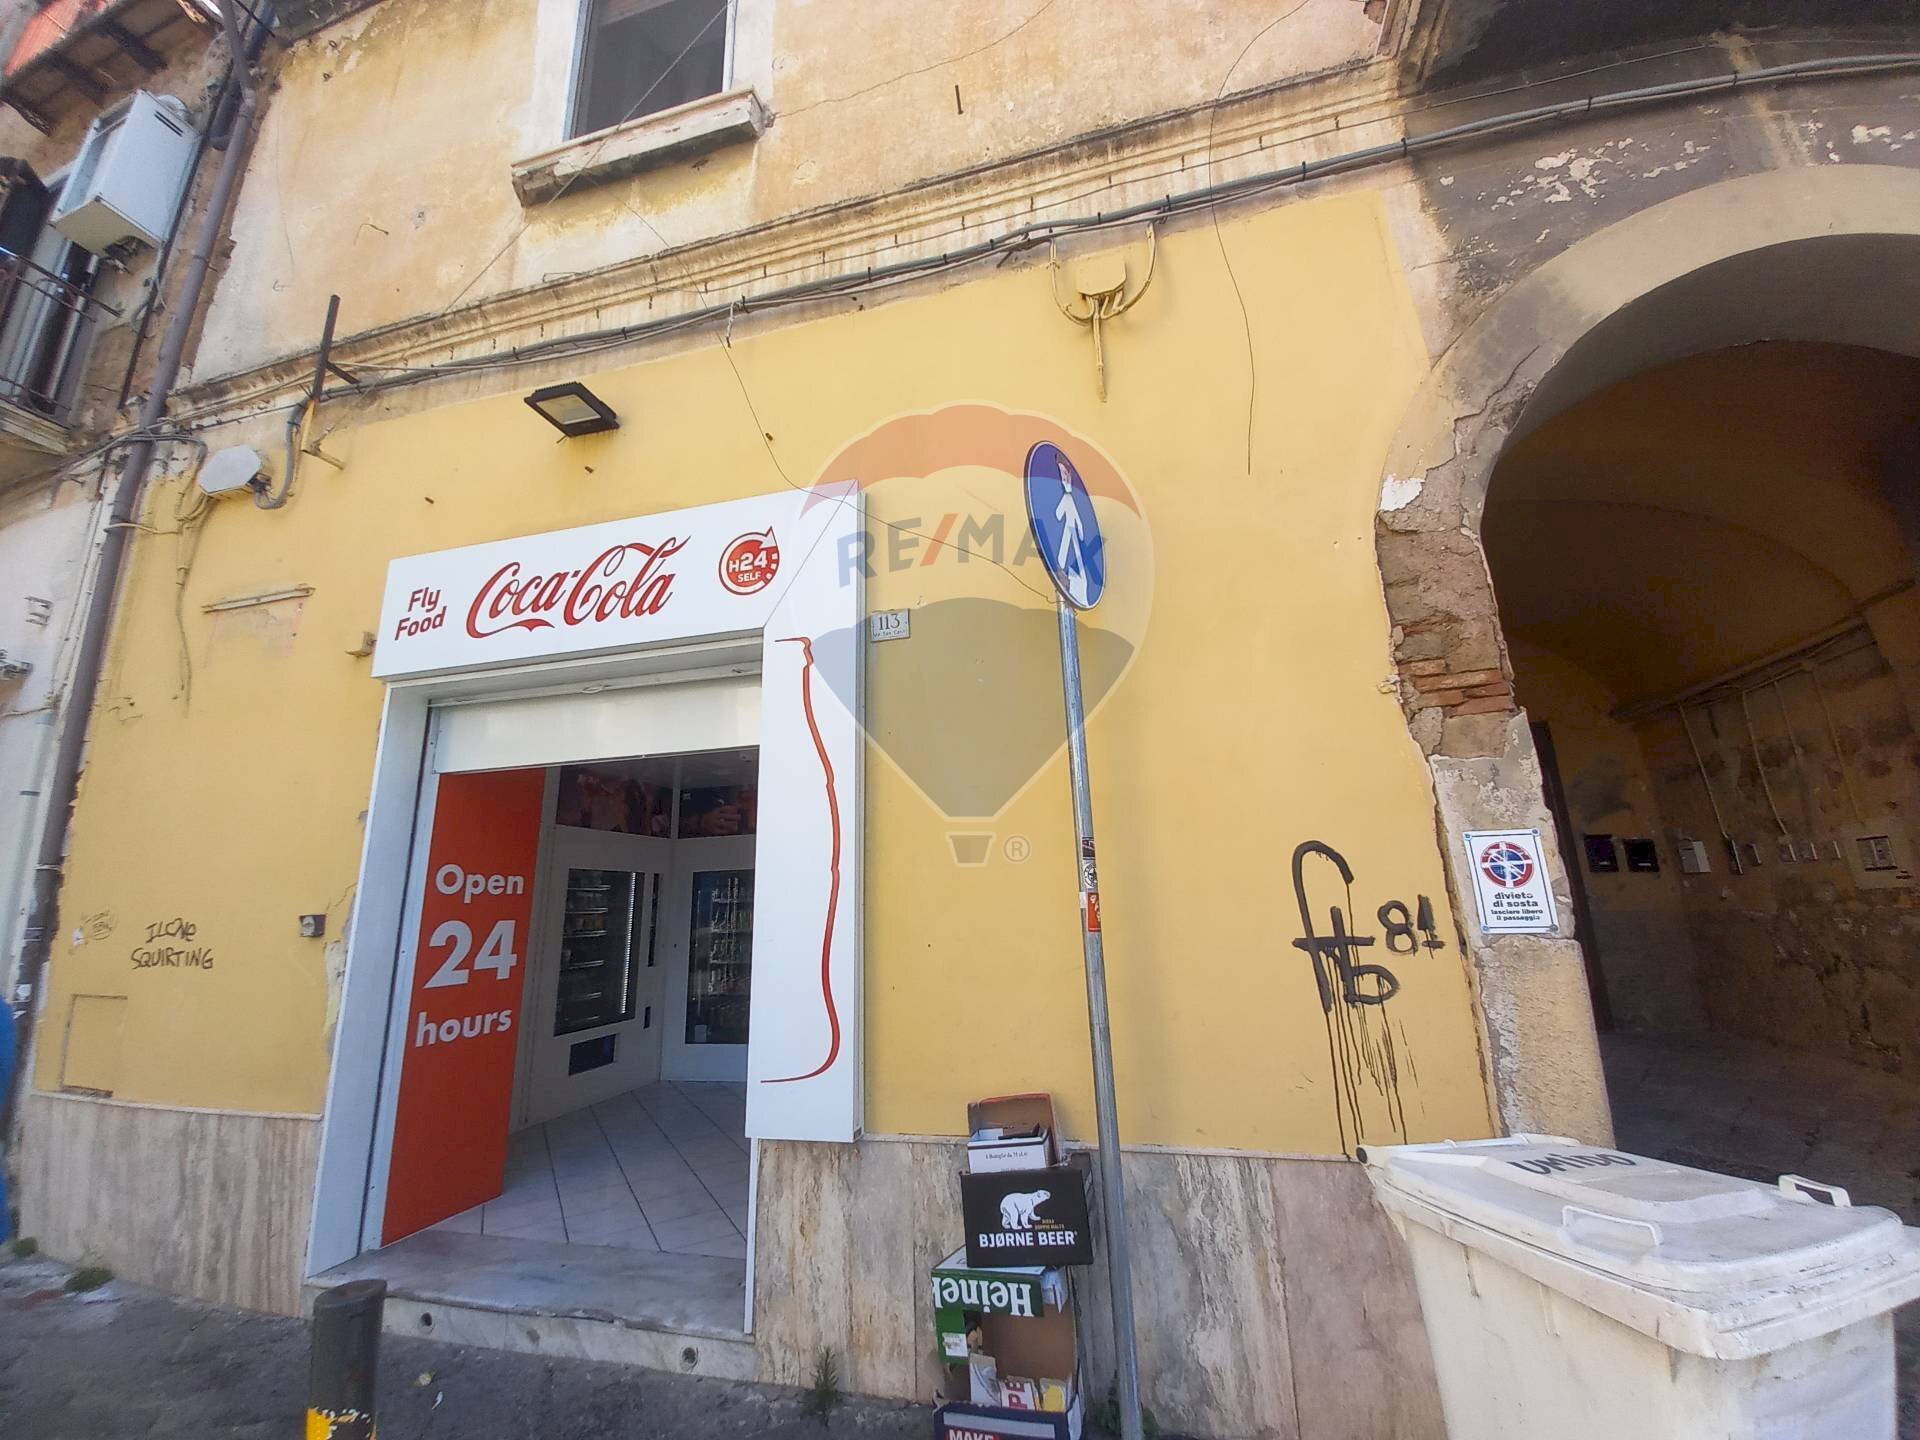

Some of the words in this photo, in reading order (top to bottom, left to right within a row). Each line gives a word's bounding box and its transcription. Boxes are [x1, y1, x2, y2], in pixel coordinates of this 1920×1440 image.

[729, 550, 768, 573] H24
[737, 571, 762, 583] SELF
[408, 587, 441, 613] Fly
[394, 606, 447, 641] Food
[879, 613, 900, 630] 113
[435, 863, 525, 904] Open
[1494, 892, 1534, 900] divieto
[130, 946, 214, 970] SQUIRTING
[423, 919, 518, 988] 24
[415, 1009, 513, 1047] hours
[979, 1232, 1034, 1248] BJØRNE
[1037, 1230, 1075, 1246] BEER
